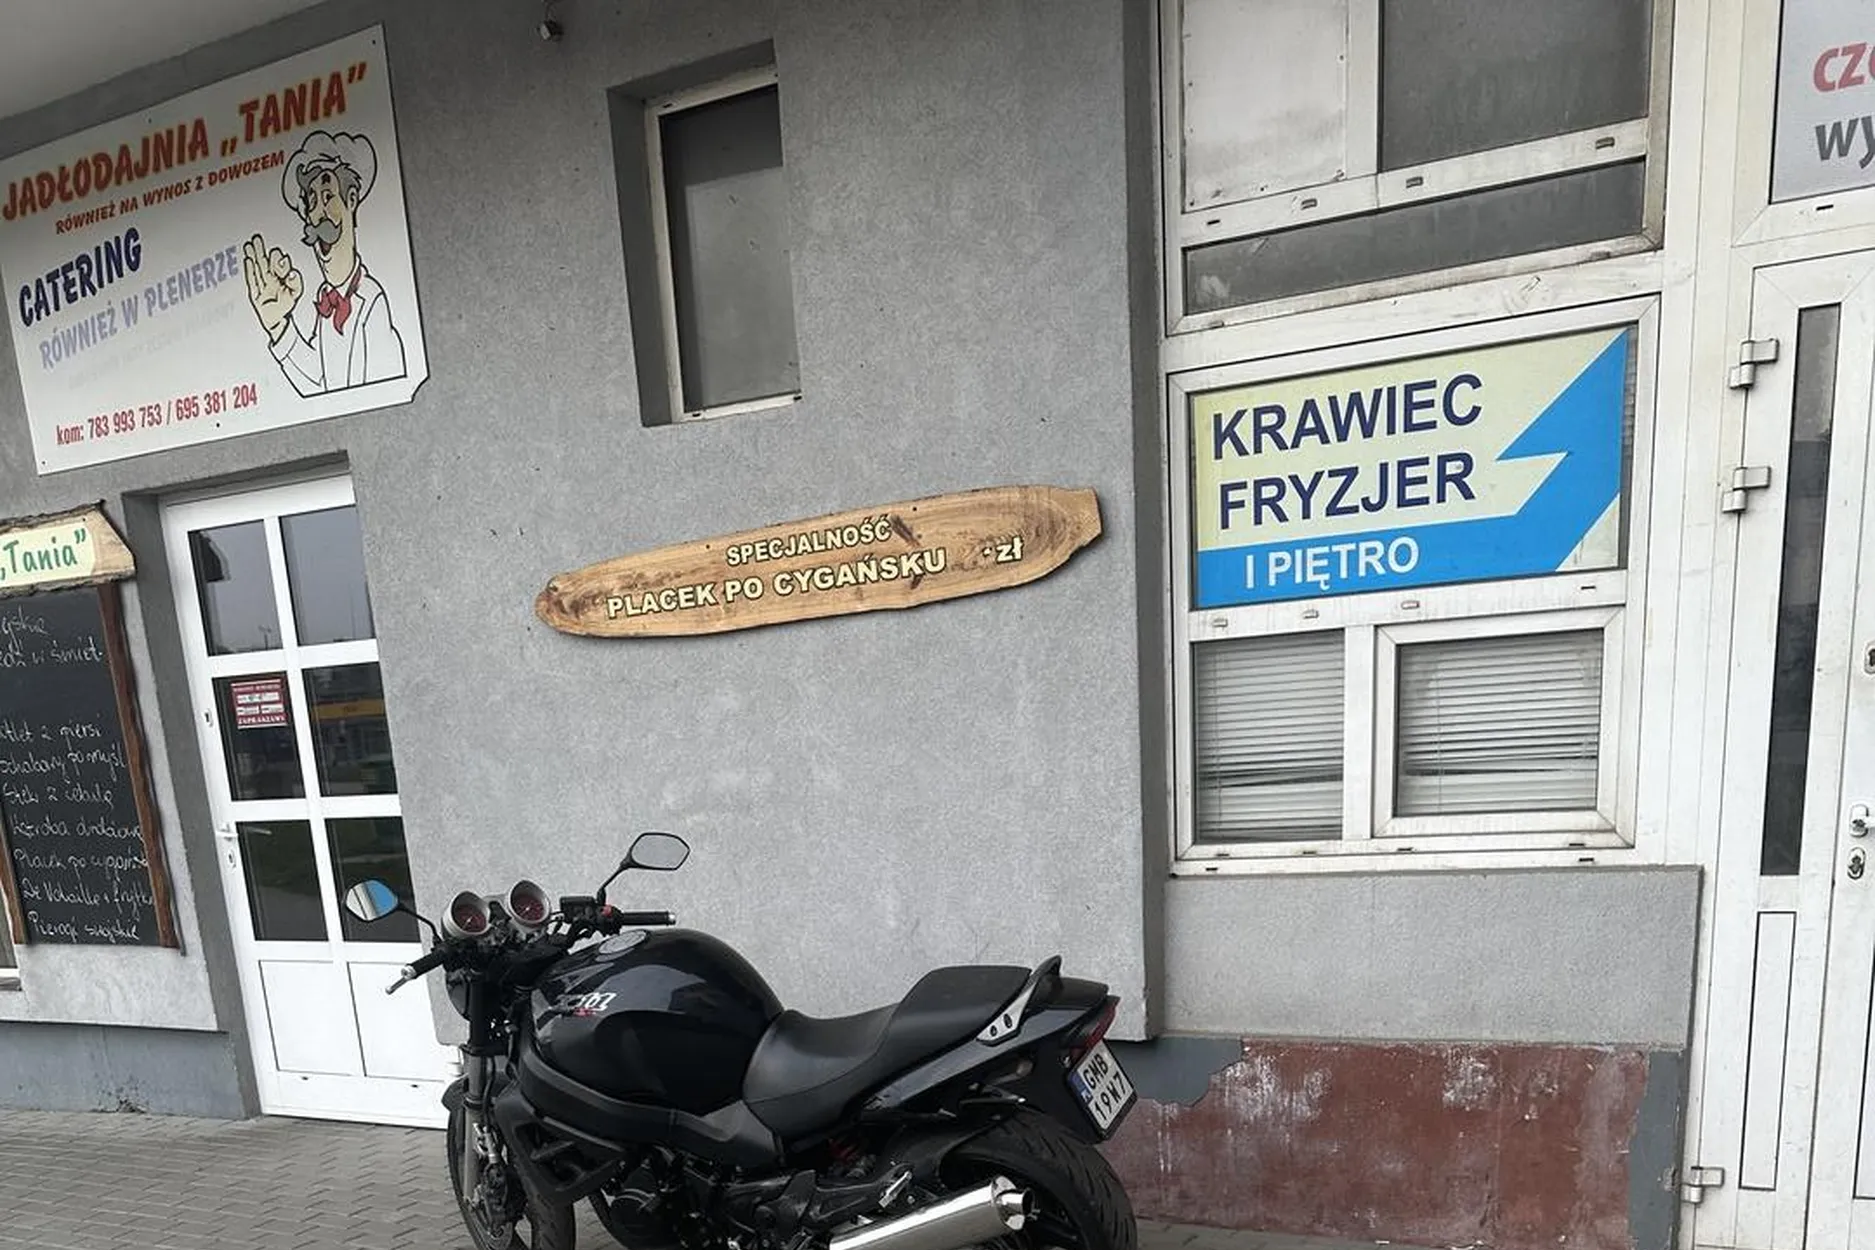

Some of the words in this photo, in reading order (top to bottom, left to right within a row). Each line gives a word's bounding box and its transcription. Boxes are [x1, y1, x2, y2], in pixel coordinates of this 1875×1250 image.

[1813, 41, 1875, 93] cz
[3, 118, 210, 221] JADŁODAJNIA
[220, 61, 367, 157] „TANIA”
[56, 203, 116, 235] RÓWNIEŻ
[120, 197, 139, 216] NA
[143, 177, 192, 208] WYNOS
[194, 175, 205, 191] Z
[207, 150, 285, 186] DOWOZEM
[18, 227, 142, 328] CATERING
[39, 301, 118, 370] RÓWNIEŻ
[121, 295, 139, 329] W
[143, 244, 239, 318] PLENERZE
[56, 424, 84, 446] kom:
[87, 415, 110, 439] 783
[113, 409, 136, 434] 993
[139, 403, 162, 428] 753
[175, 396, 200, 421] 695
[204, 389, 228, 415] 381
[232, 383, 258, 409] 204
[1212, 373, 1483, 461] KRAWIEC
[1219, 451, 1477, 531] FRYZJER
[606, 580, 719, 620] PLACEK
[724, 576, 765, 603] PO
[772, 547, 947, 596] CYGAŃSKU
[995, 535, 1024, 563] zł
[726, 513, 893, 567] SPECJALNOŚĆ
[1244, 554, 1256, 589] I
[1267, 535, 1420, 591] PIĘTRO
[1082, 1053, 1109, 1090] GMB
